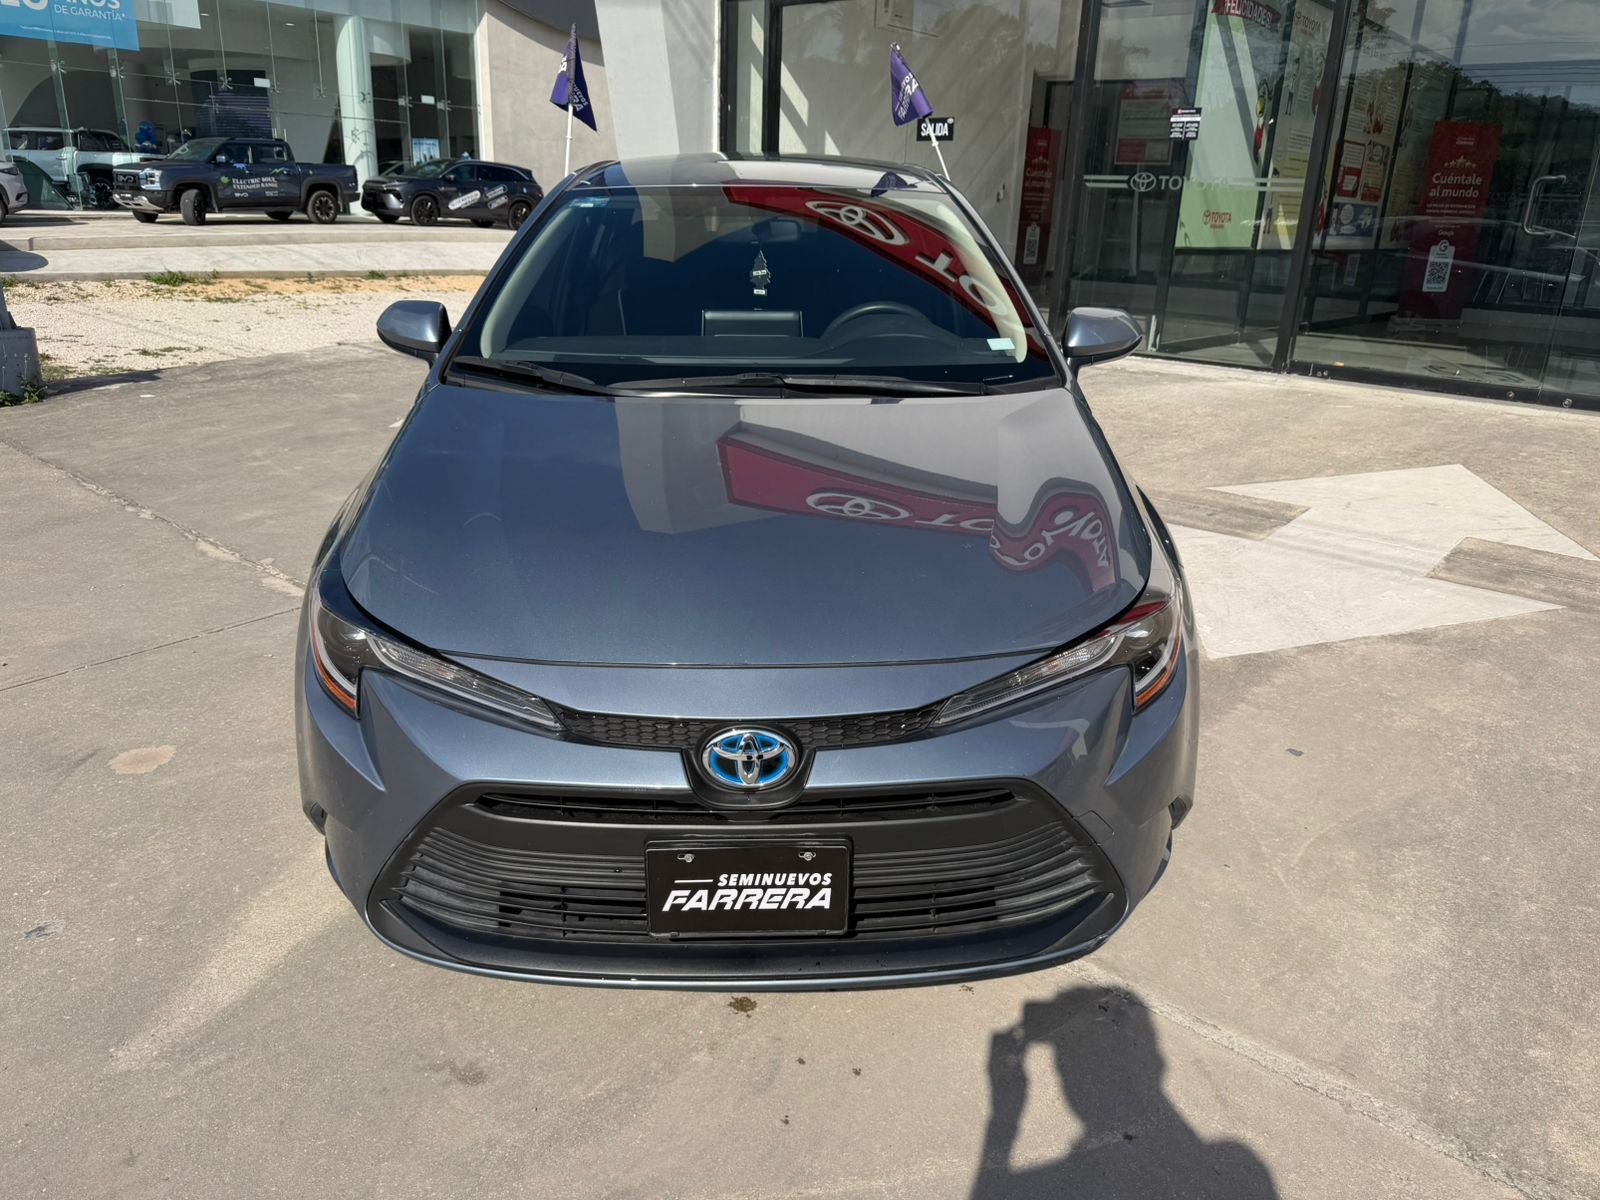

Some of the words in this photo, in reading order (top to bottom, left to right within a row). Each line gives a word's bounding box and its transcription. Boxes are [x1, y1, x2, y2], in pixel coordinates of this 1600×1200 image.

[54, 4, 69, 14] DE
[1432, 172, 1482, 185] Cuéntale
[1430, 186, 1440, 197] al
[1441, 187, 1480, 198] mundo
[1210, 211, 1232, 225] TOYOTA
[717, 873, 833, 887] SEMINUEVOS
[661, 888, 832, 912] FARRERA
